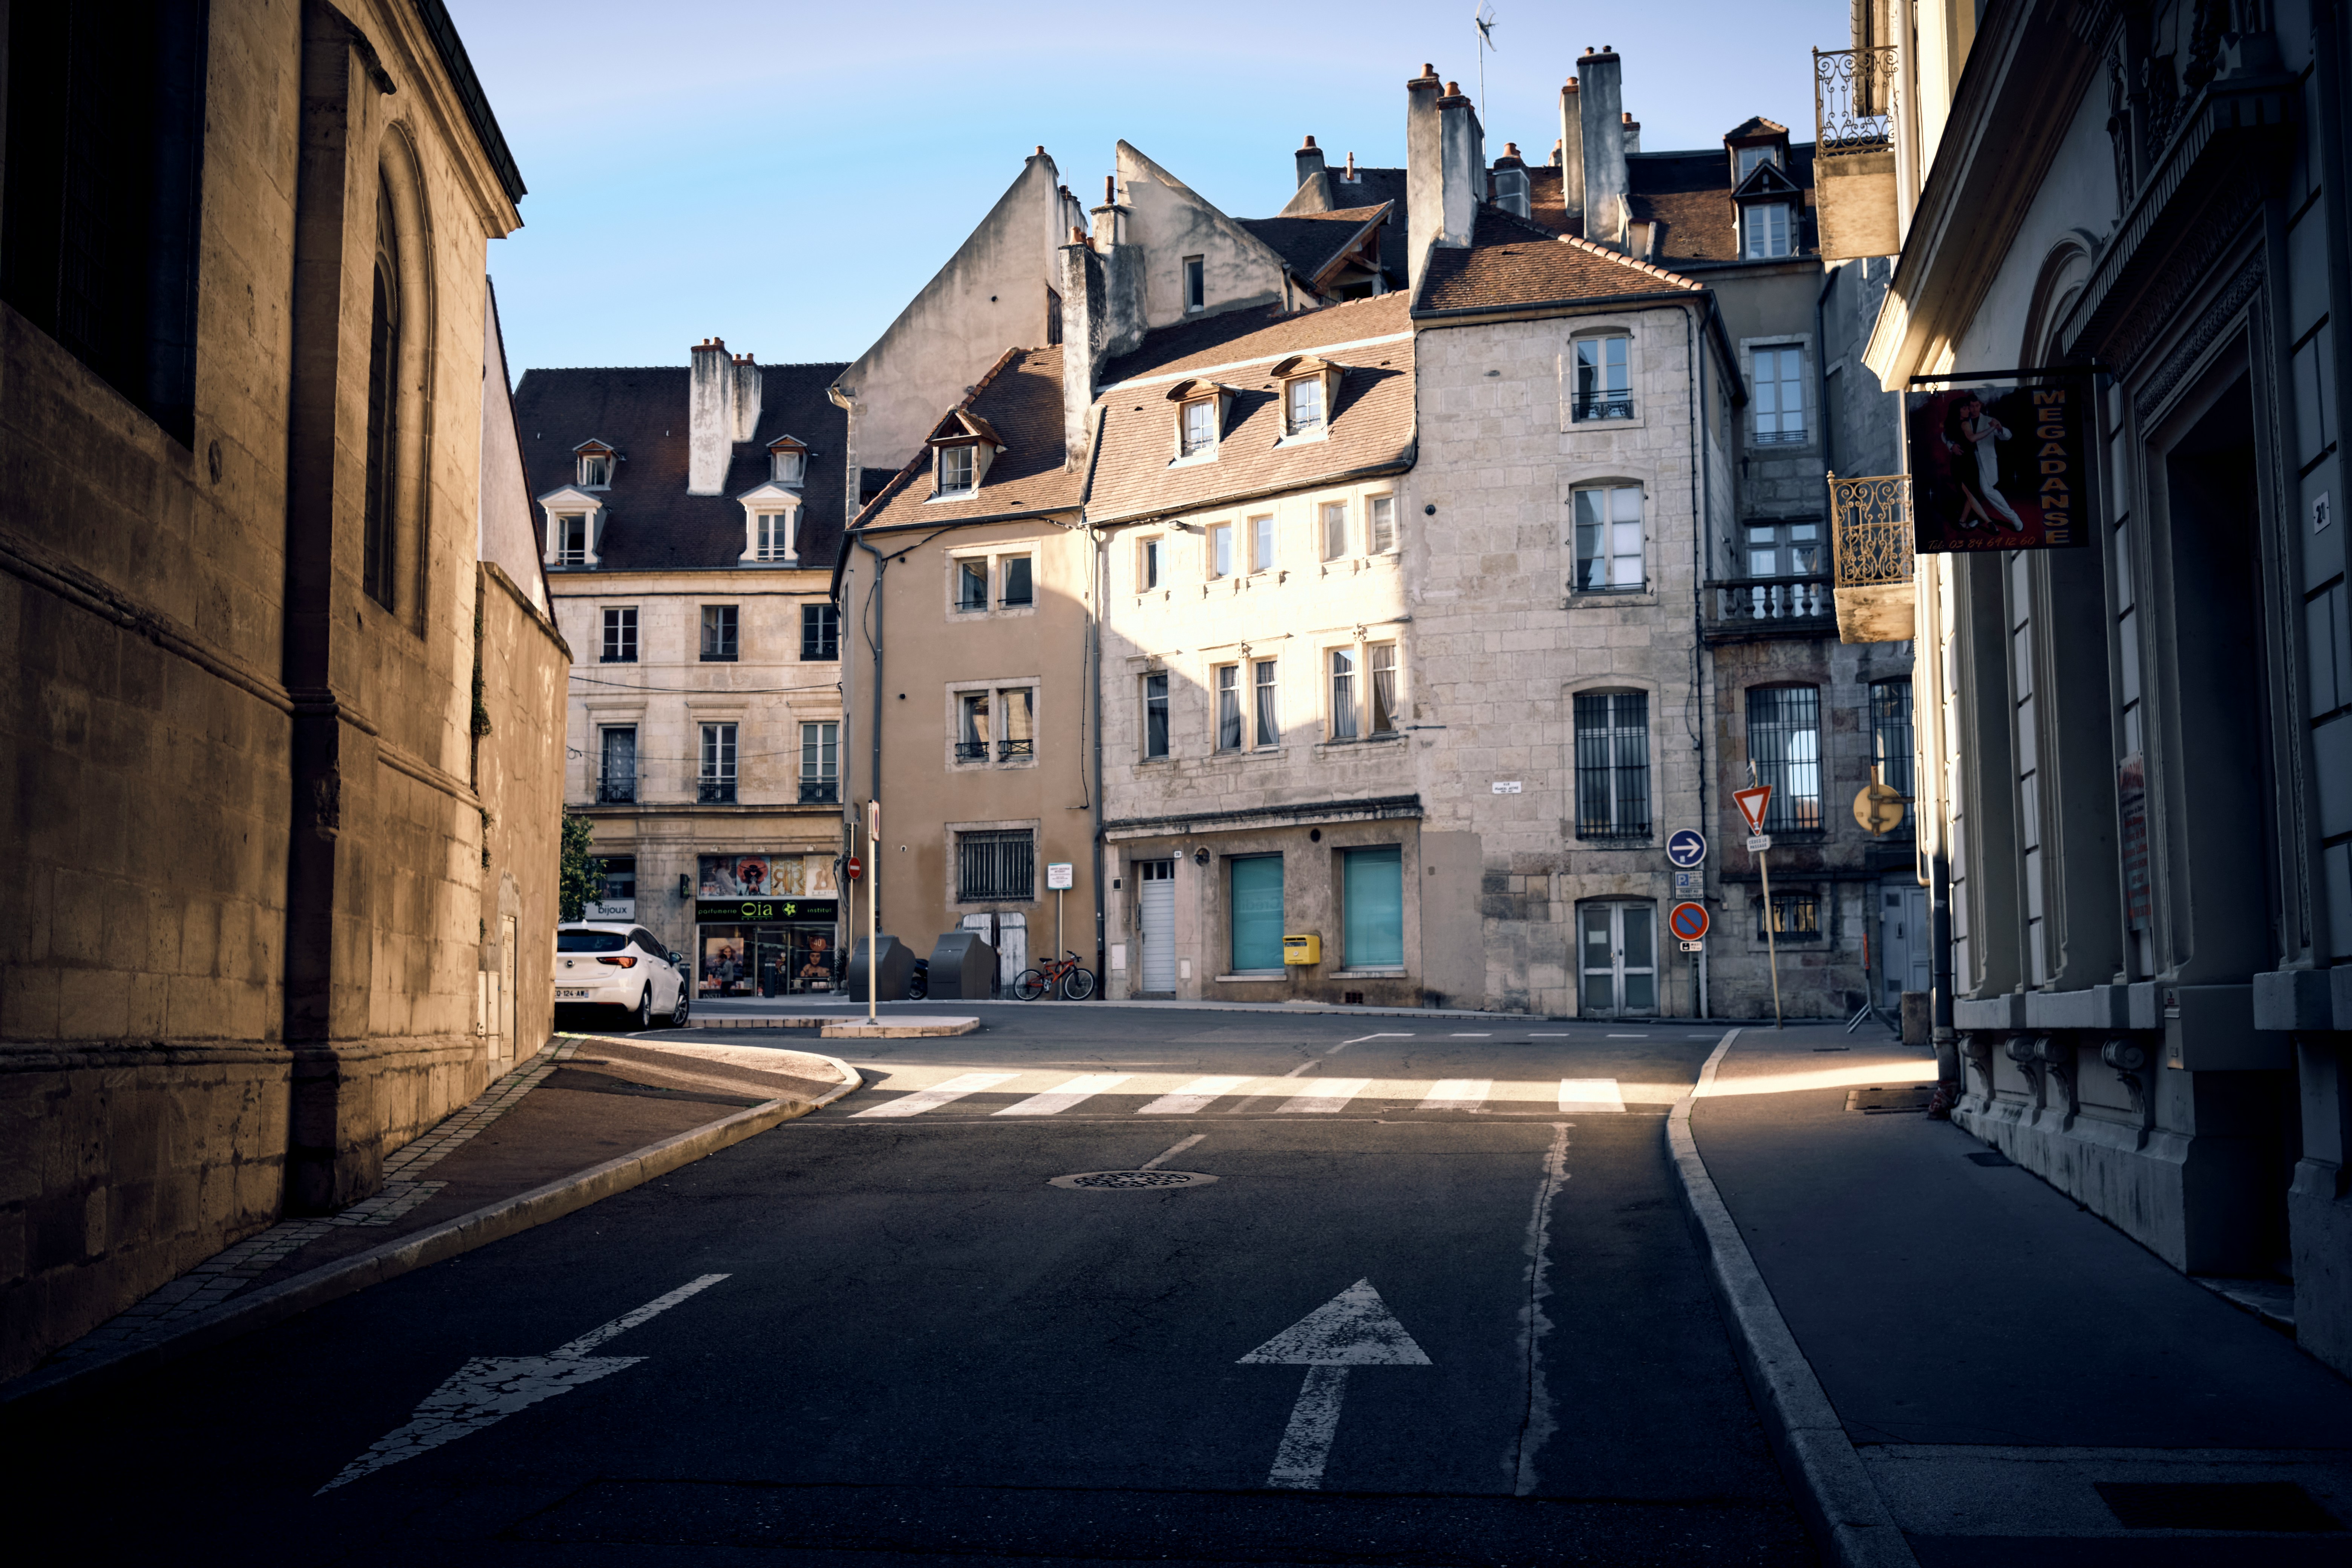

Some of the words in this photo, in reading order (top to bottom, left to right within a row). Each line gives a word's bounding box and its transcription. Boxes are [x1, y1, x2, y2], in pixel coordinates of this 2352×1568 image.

[2033, 389, 2070, 544] MEGADANSE
[2316, 502, 2326, 524] 21
[1949, 540, 1964, 549] 03
[1968, 538, 1983, 548] 84
[1987, 537, 2003, 547] 69
[2005, 537, 2017, 545] 12
[2020, 536, 2036, 545] 60
[598, 904, 627, 916] bijoux
